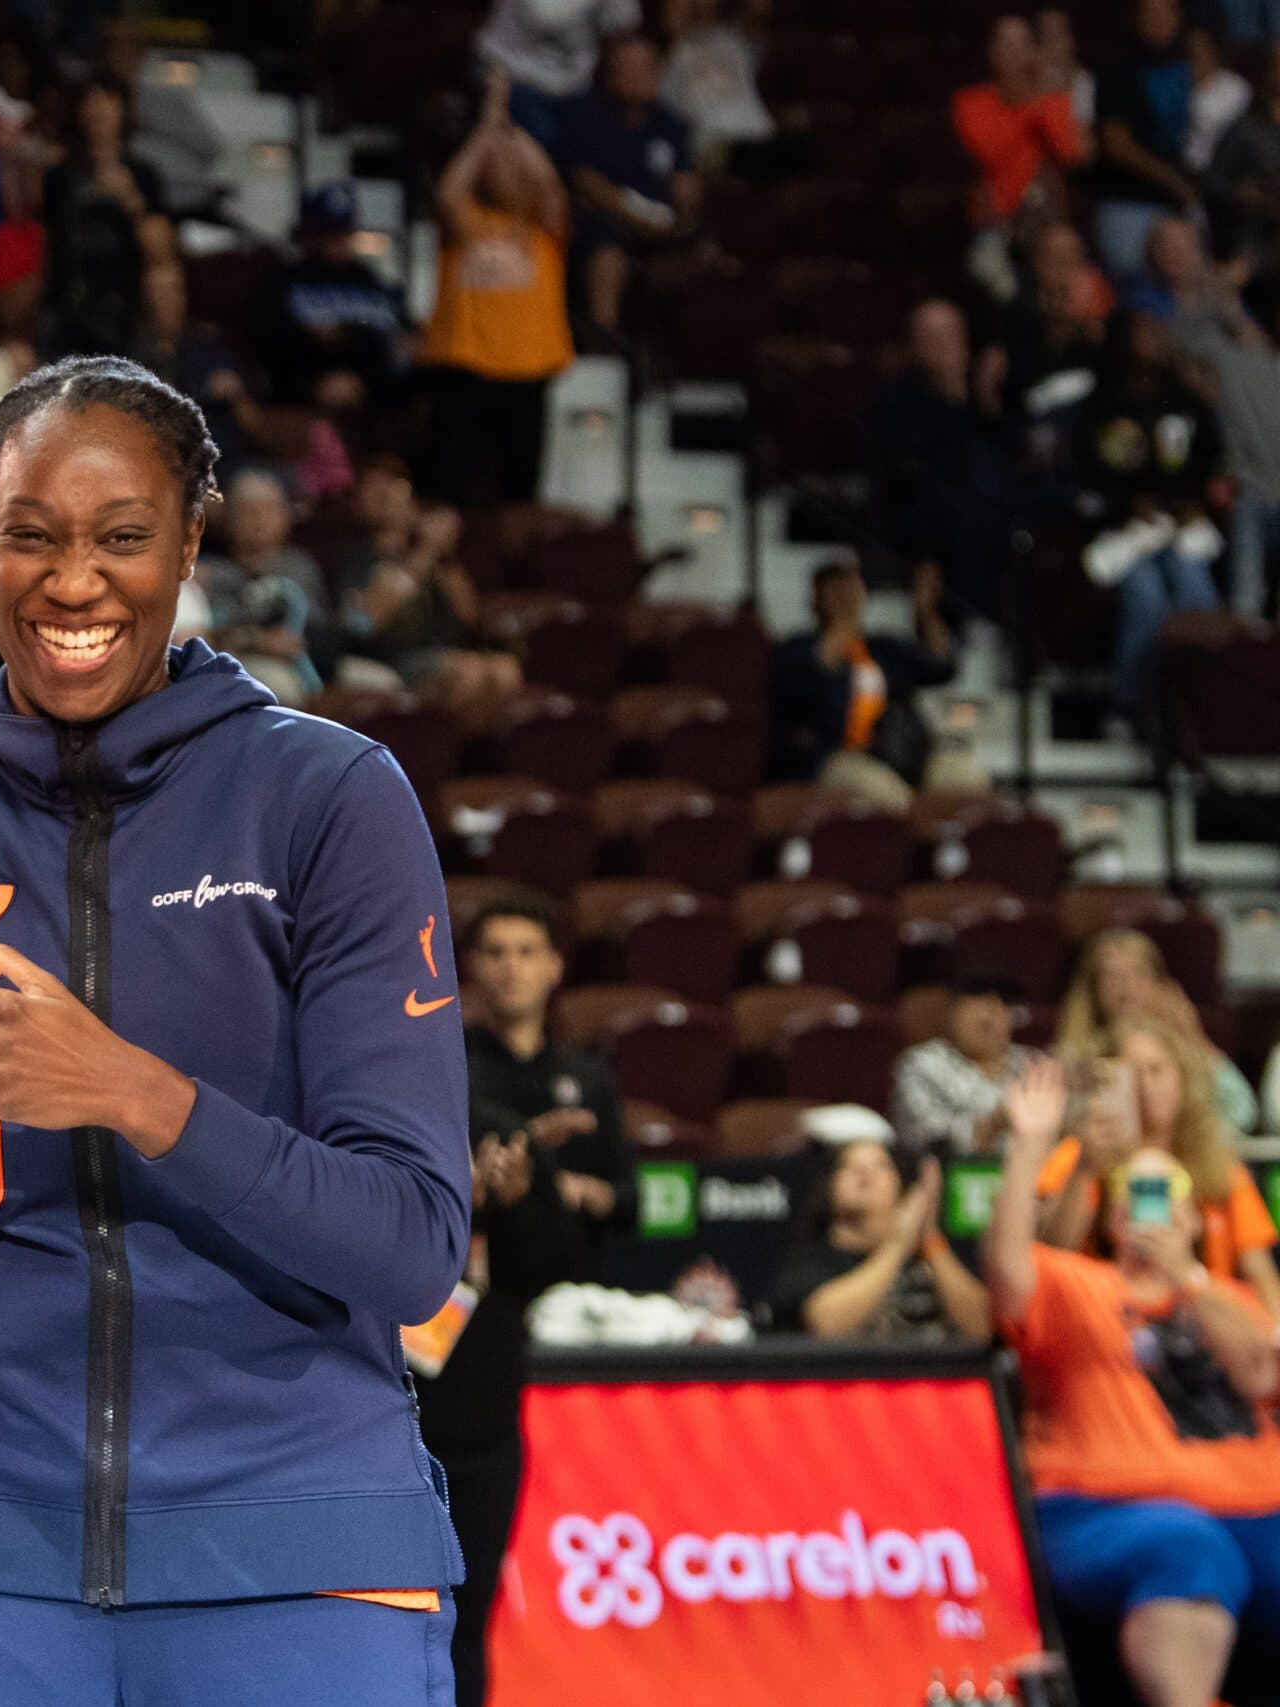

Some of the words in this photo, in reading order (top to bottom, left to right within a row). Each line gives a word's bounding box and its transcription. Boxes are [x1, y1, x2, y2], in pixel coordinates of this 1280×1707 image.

[152, 890, 192, 907] GOFF
[194, 874, 232, 908] law
[700, 1176, 790, 1220] Bank
[660, 1508, 980, 1603] carelon
